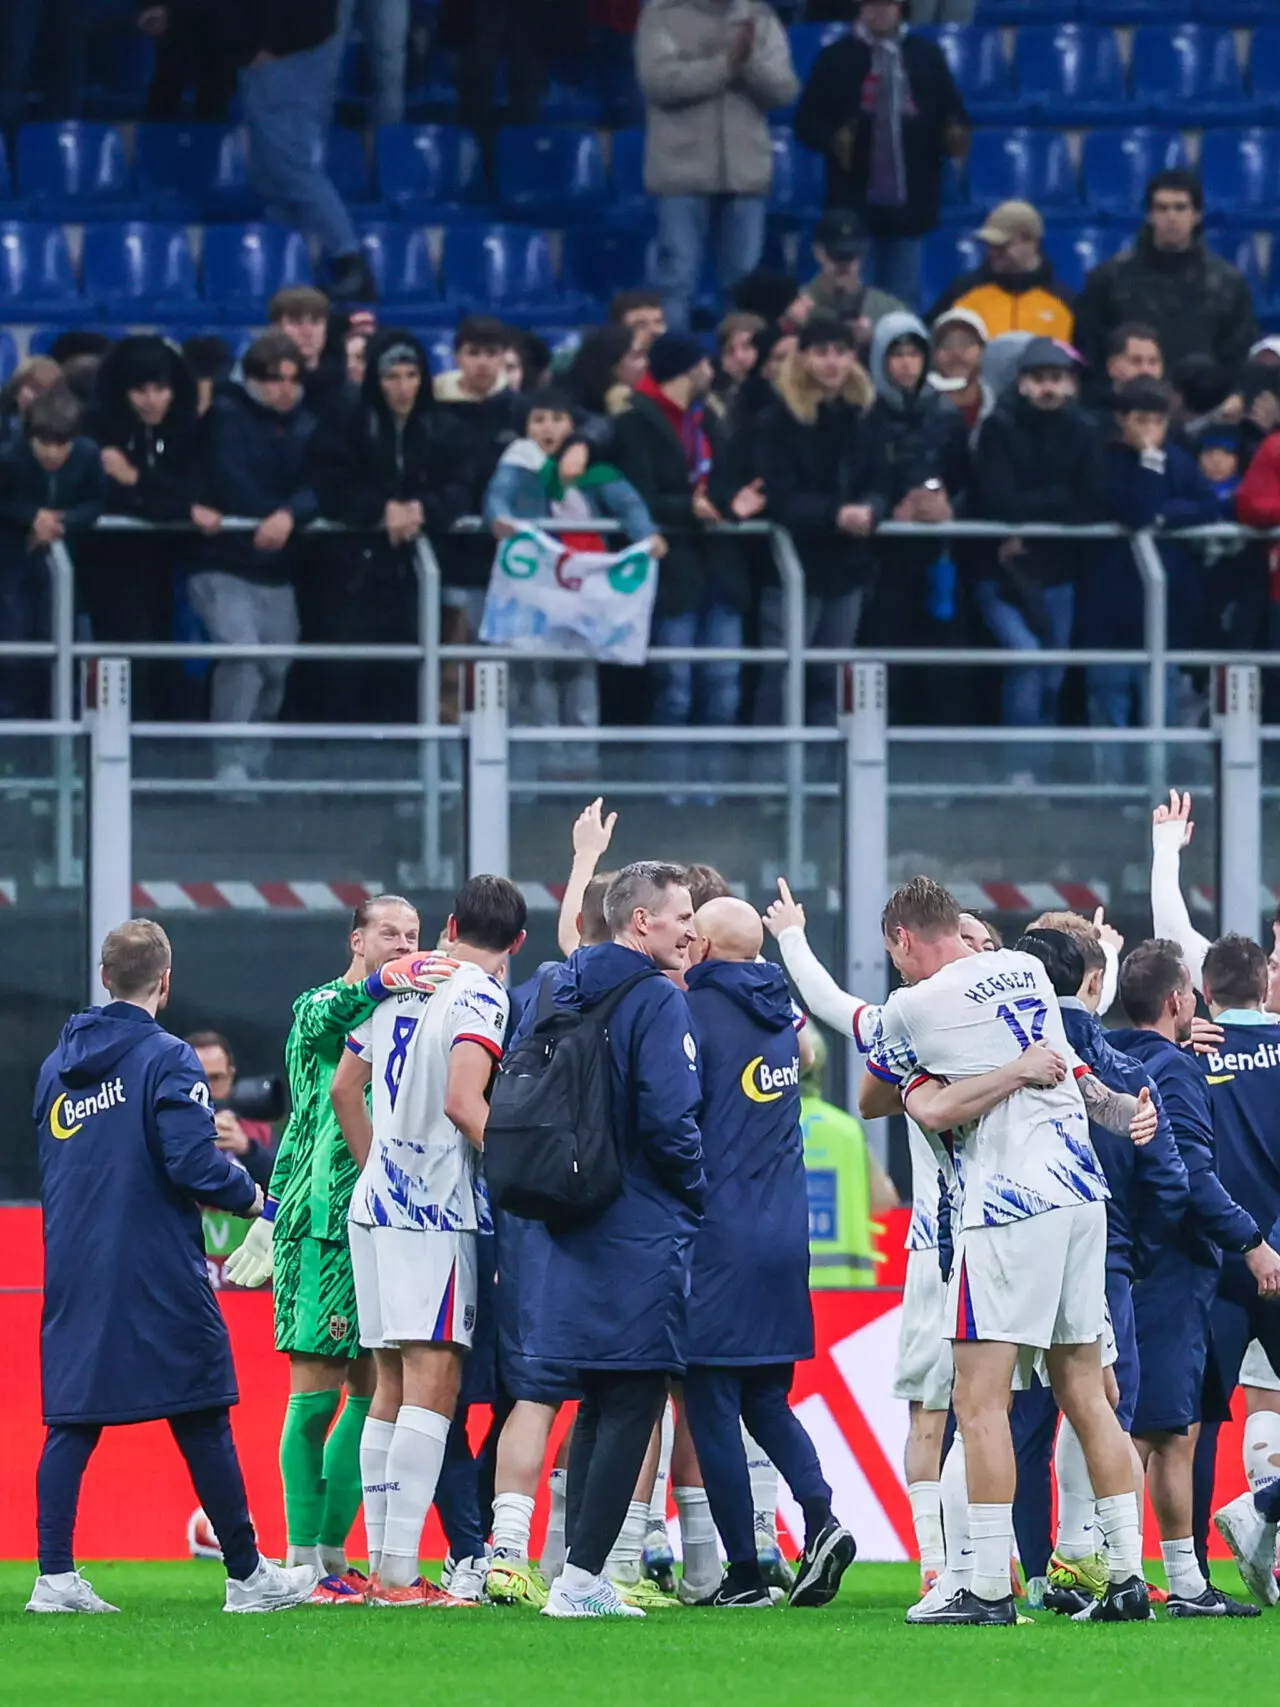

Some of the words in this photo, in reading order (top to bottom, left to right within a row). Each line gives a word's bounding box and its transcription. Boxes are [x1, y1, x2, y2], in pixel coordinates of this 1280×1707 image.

[964, 971, 1036, 1004] HEGGEM
[996, 997, 1048, 1052] 17
[384, 1016, 419, 1114] 8
[64, 1077, 126, 1126] Bendit
